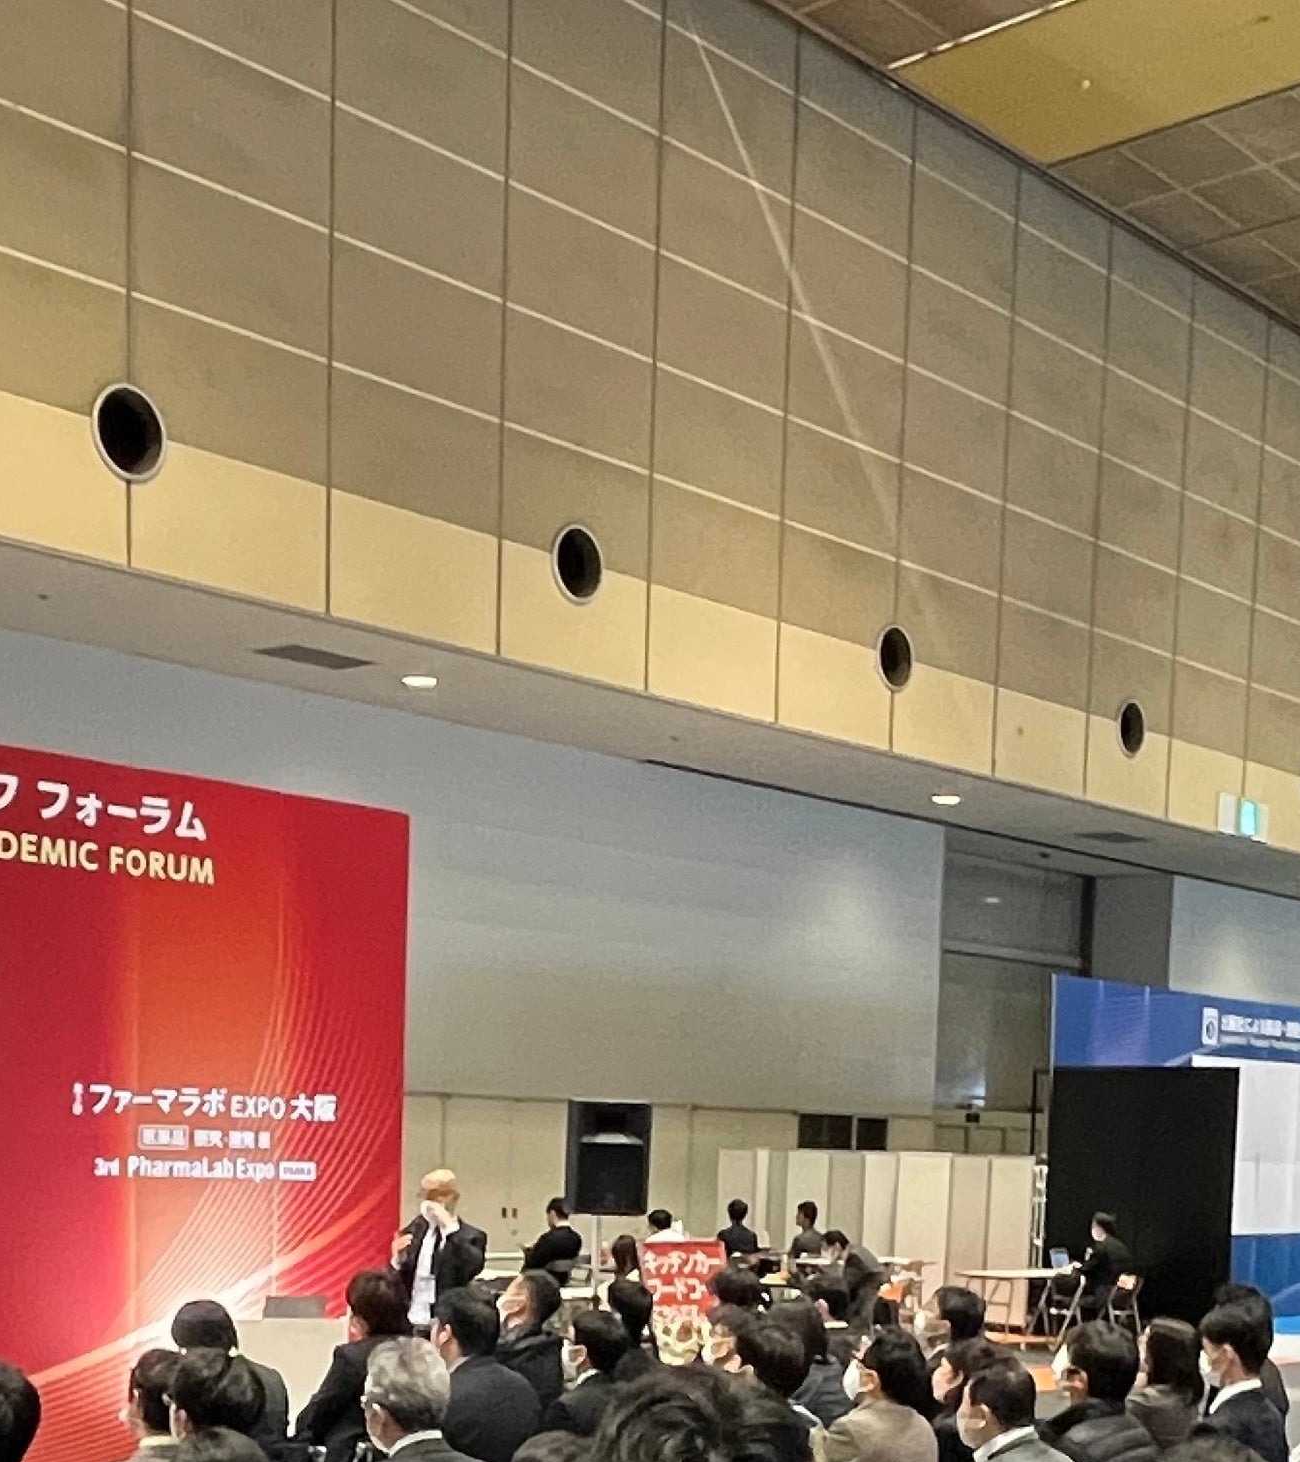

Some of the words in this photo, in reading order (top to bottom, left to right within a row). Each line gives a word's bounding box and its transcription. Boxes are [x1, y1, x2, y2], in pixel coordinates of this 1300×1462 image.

[37, 780, 207, 841] フォーラム
[109, 845, 215, 885] FORUM
[89, 1084, 228, 1118] ファーマラボ
[230, 1095, 287, 1120] EXPO
[290, 1093, 338, 1121] 大阪
[94, 1157, 120, 1177] 3rd
[127, 1155, 234, 1179] PharmaLab
[236, 1158, 275, 1183] Expo
